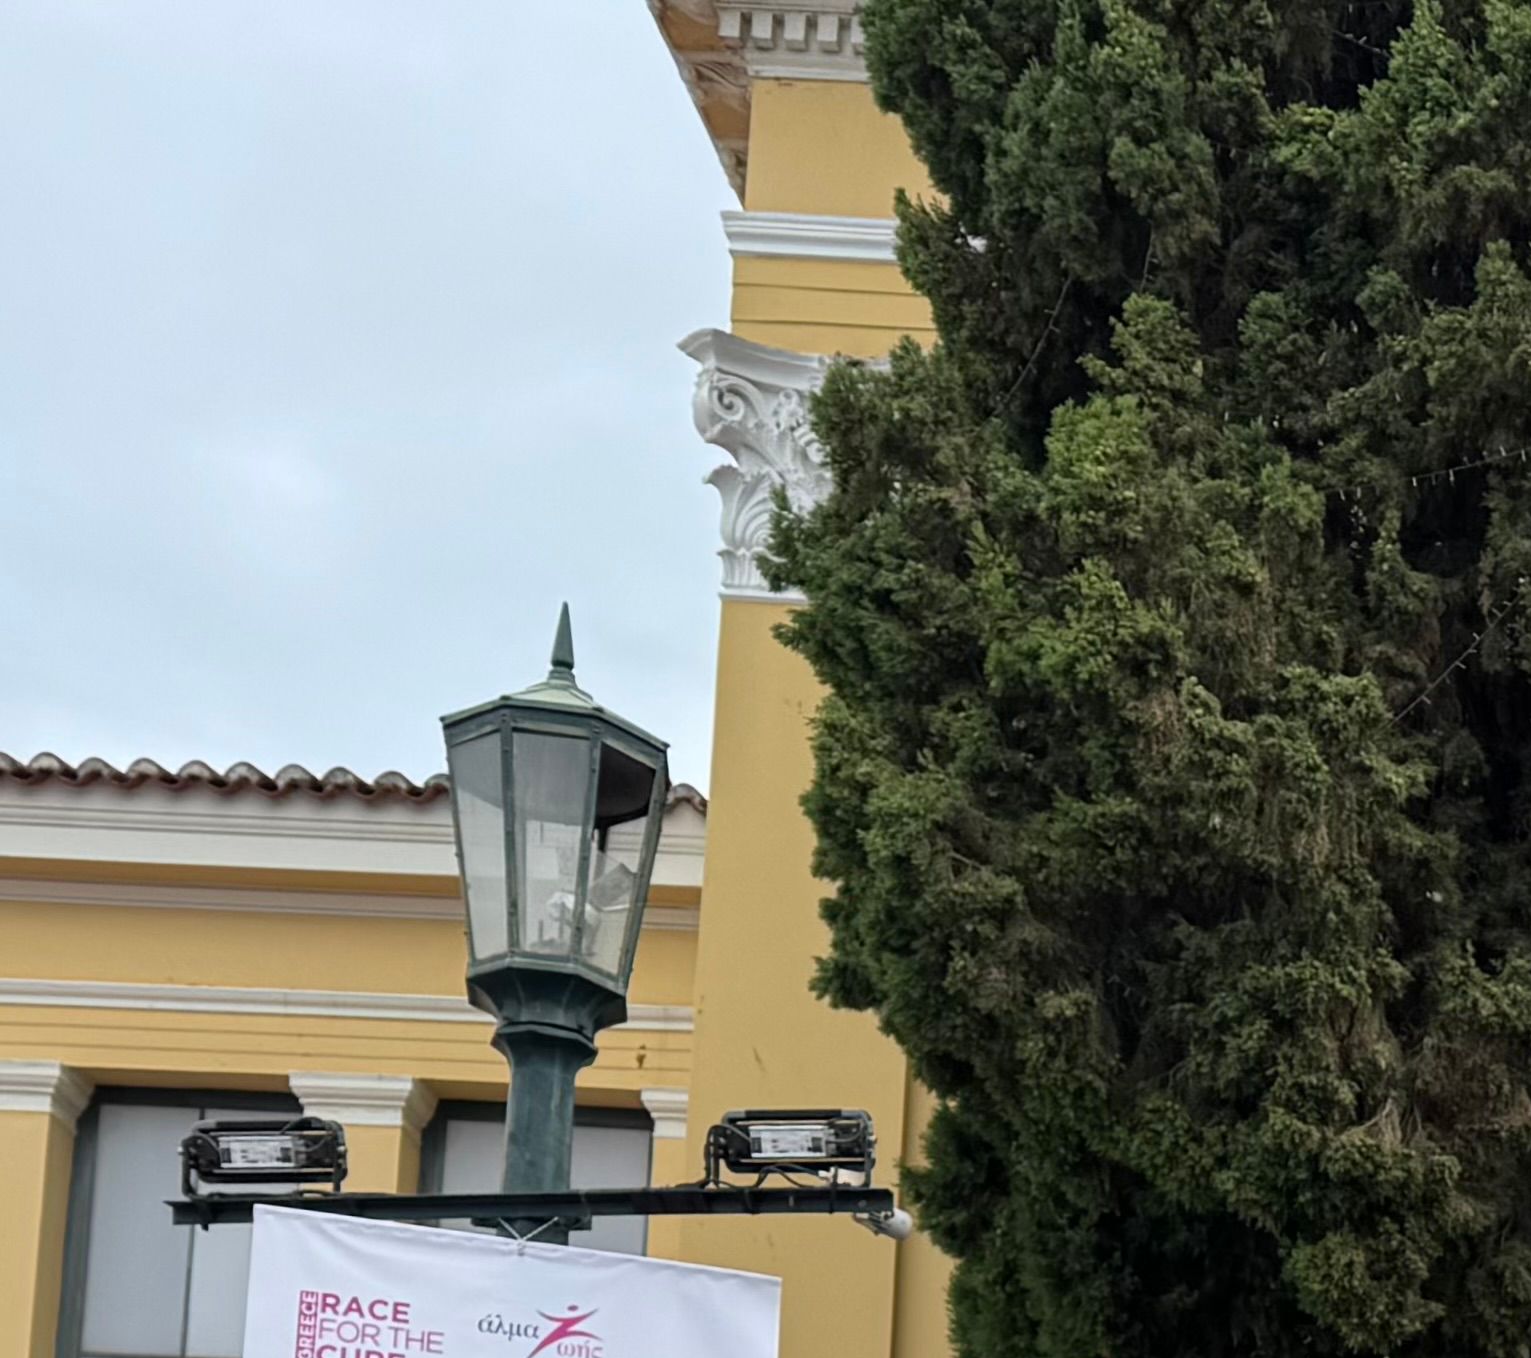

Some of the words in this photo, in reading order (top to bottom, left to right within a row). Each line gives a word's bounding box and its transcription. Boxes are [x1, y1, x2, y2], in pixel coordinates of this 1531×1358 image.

[320, 1292, 411, 1324] RACE
[318, 1318, 382, 1347] FOR
[388, 1325, 445, 1355] THE
[477, 1313, 539, 1341] άλμα
